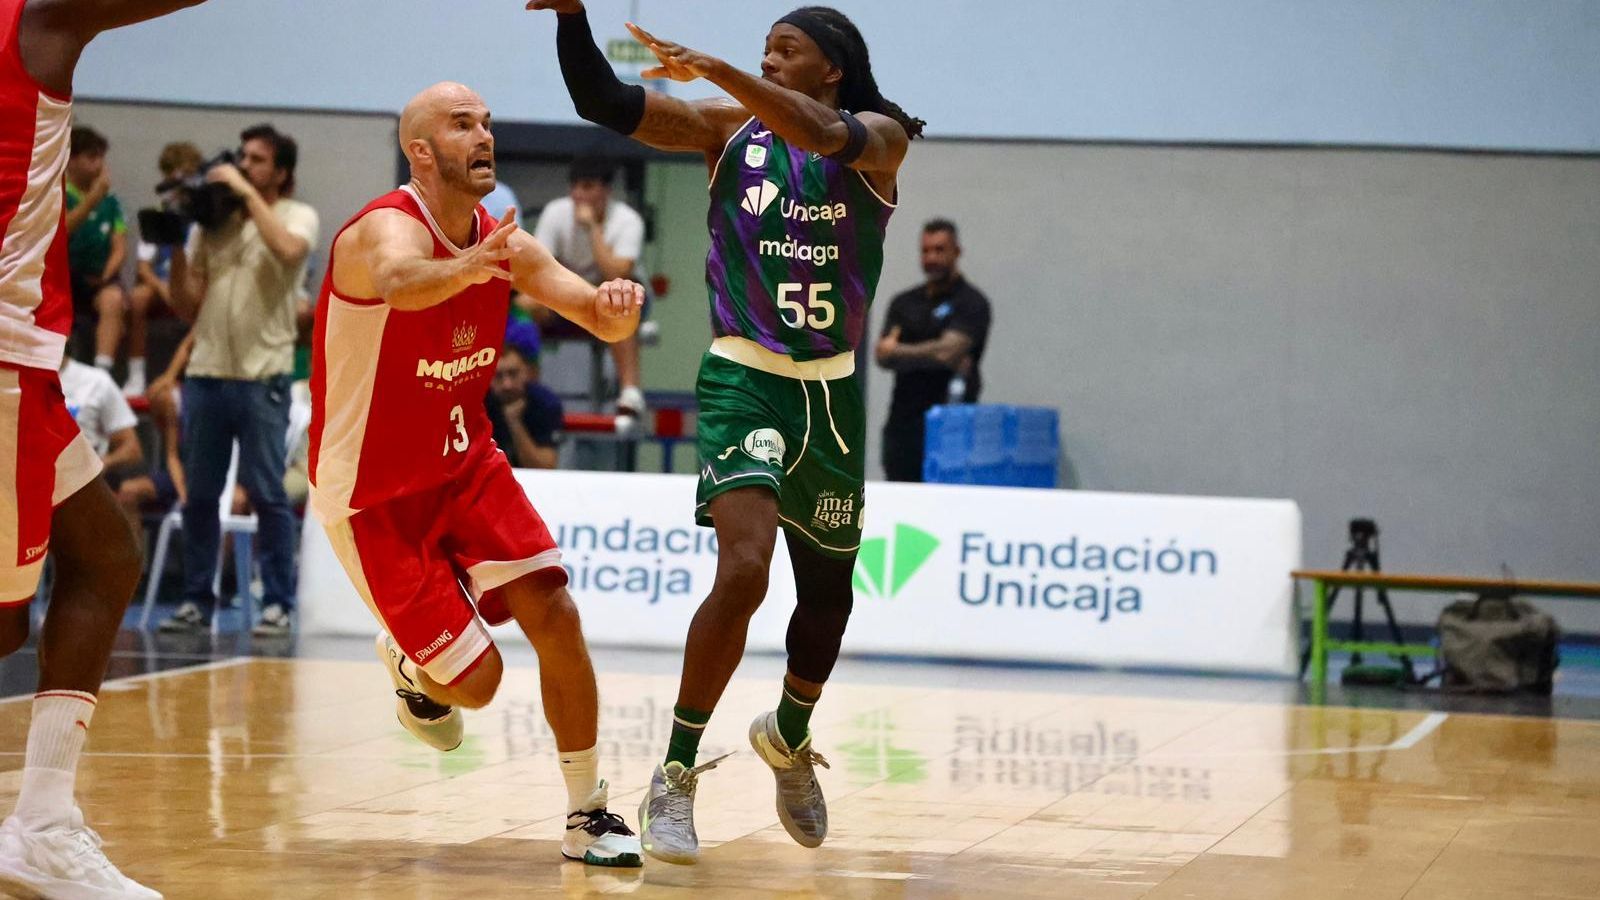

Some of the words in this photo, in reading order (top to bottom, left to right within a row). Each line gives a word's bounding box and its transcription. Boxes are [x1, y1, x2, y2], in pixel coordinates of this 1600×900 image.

[776, 282, 836, 330] 55
[442, 404, 470, 457] 3
[960, 531, 1218, 576] Fundación
[958, 571, 1142, 623] Unicaja
[415, 629, 453, 662] SPALDING
